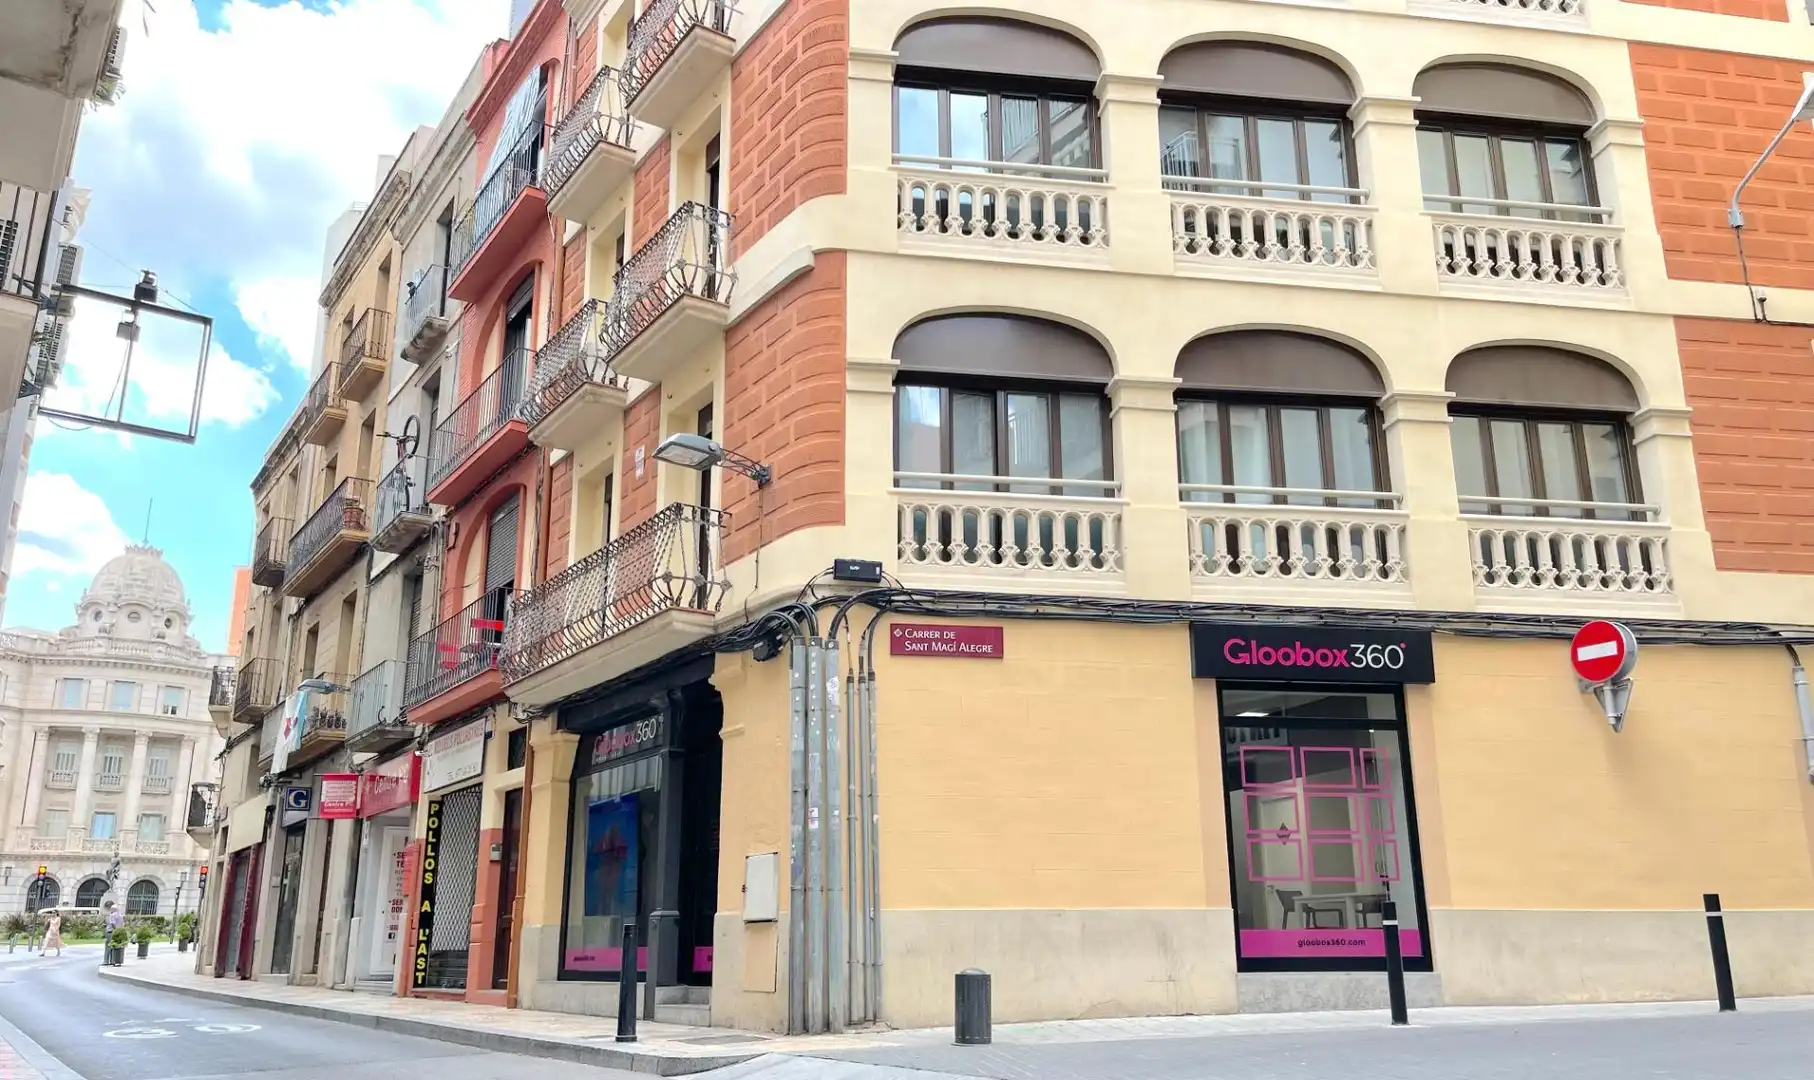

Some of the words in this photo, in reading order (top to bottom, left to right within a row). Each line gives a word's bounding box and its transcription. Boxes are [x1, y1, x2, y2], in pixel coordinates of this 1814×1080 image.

[904, 628, 941, 639] CARRER
[943, 630, 957, 640] DE
[904, 640, 929, 652] SANT
[931, 641, 957, 653] MAGÍ
[958, 642, 994, 653] ALEGRE
[288, 789, 307, 808] G
[423, 802, 440, 885] POLLOS
[421, 900, 432, 913] A
[1297, 937, 1366, 948] gloobox360.com
[415, 928, 430, 985] L'AST
